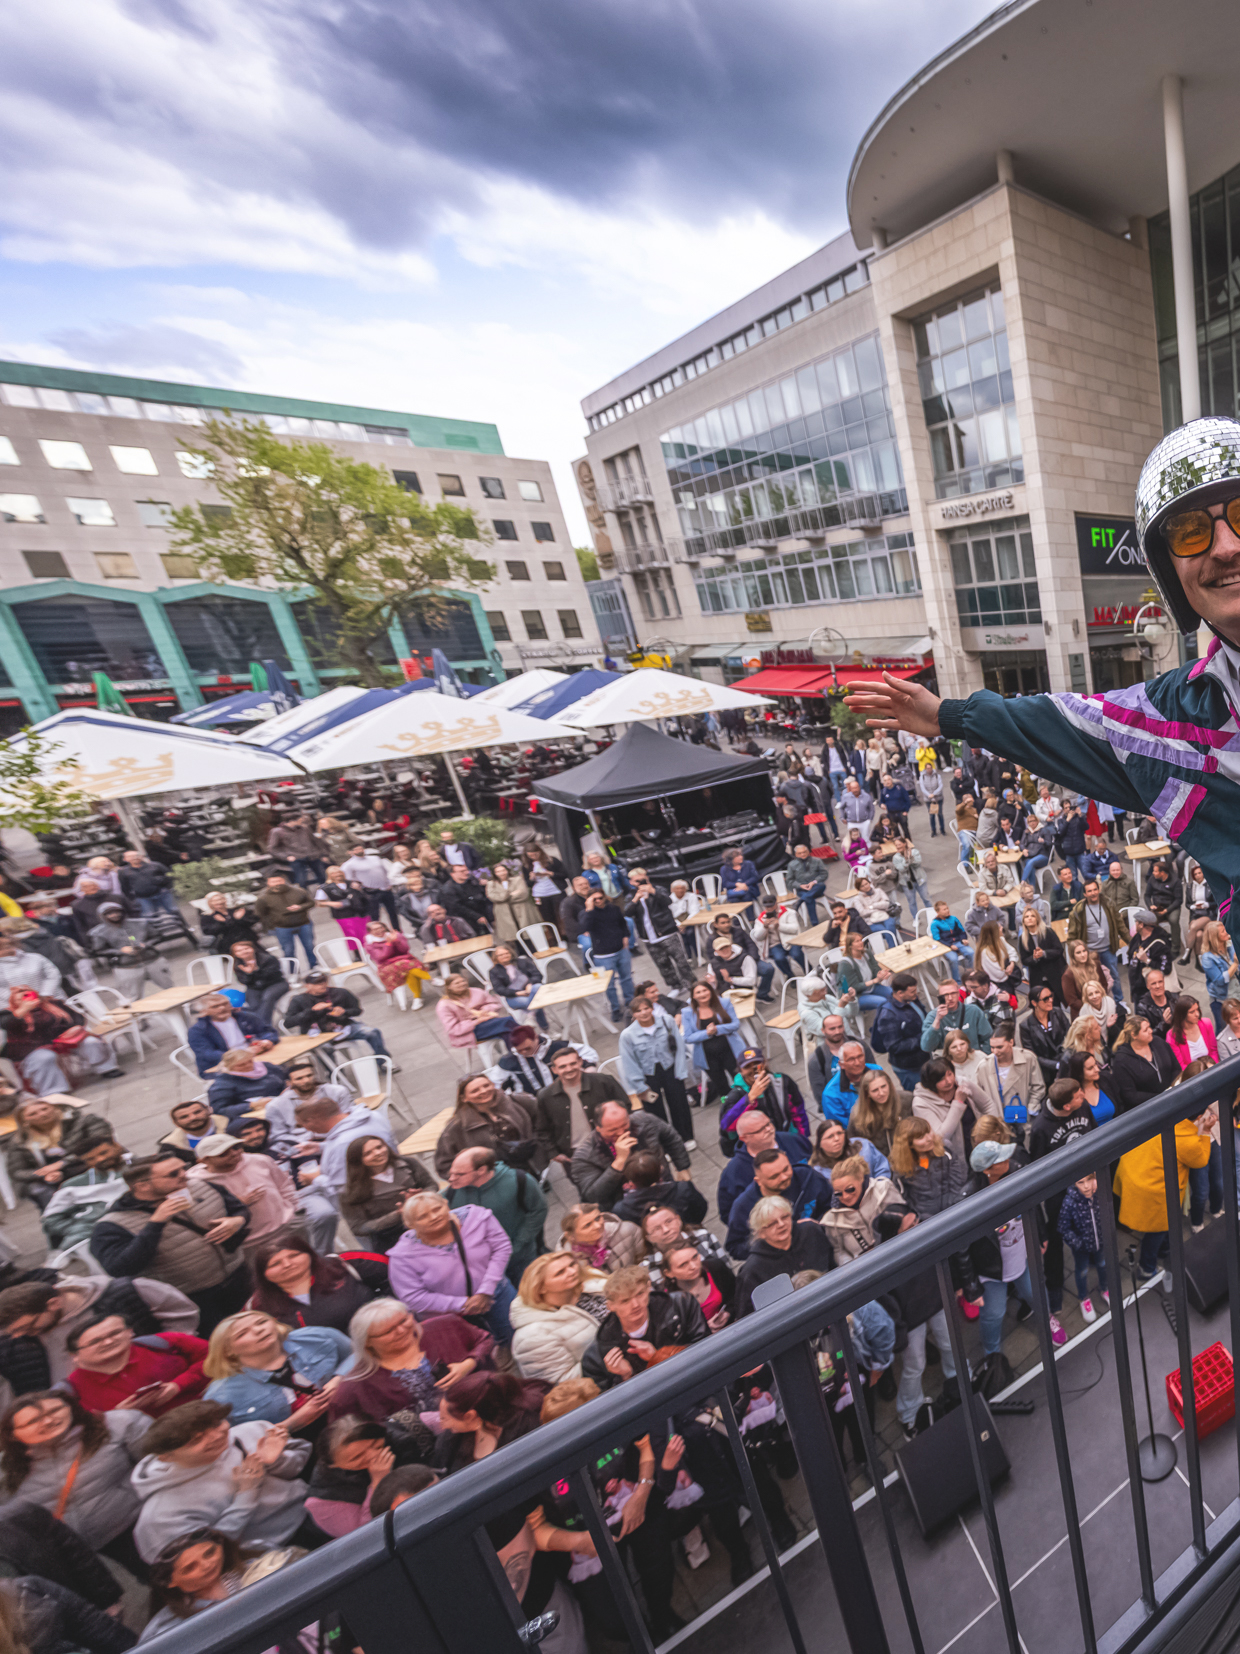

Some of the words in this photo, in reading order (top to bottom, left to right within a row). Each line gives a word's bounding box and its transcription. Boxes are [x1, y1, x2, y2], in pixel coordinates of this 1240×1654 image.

[941, 501, 977, 519] HANSA
[1091, 527, 1116, 548] FIT
[1050, 1126, 1066, 1144] TOM
[1066, 1116, 1089, 1129] TAILOR
